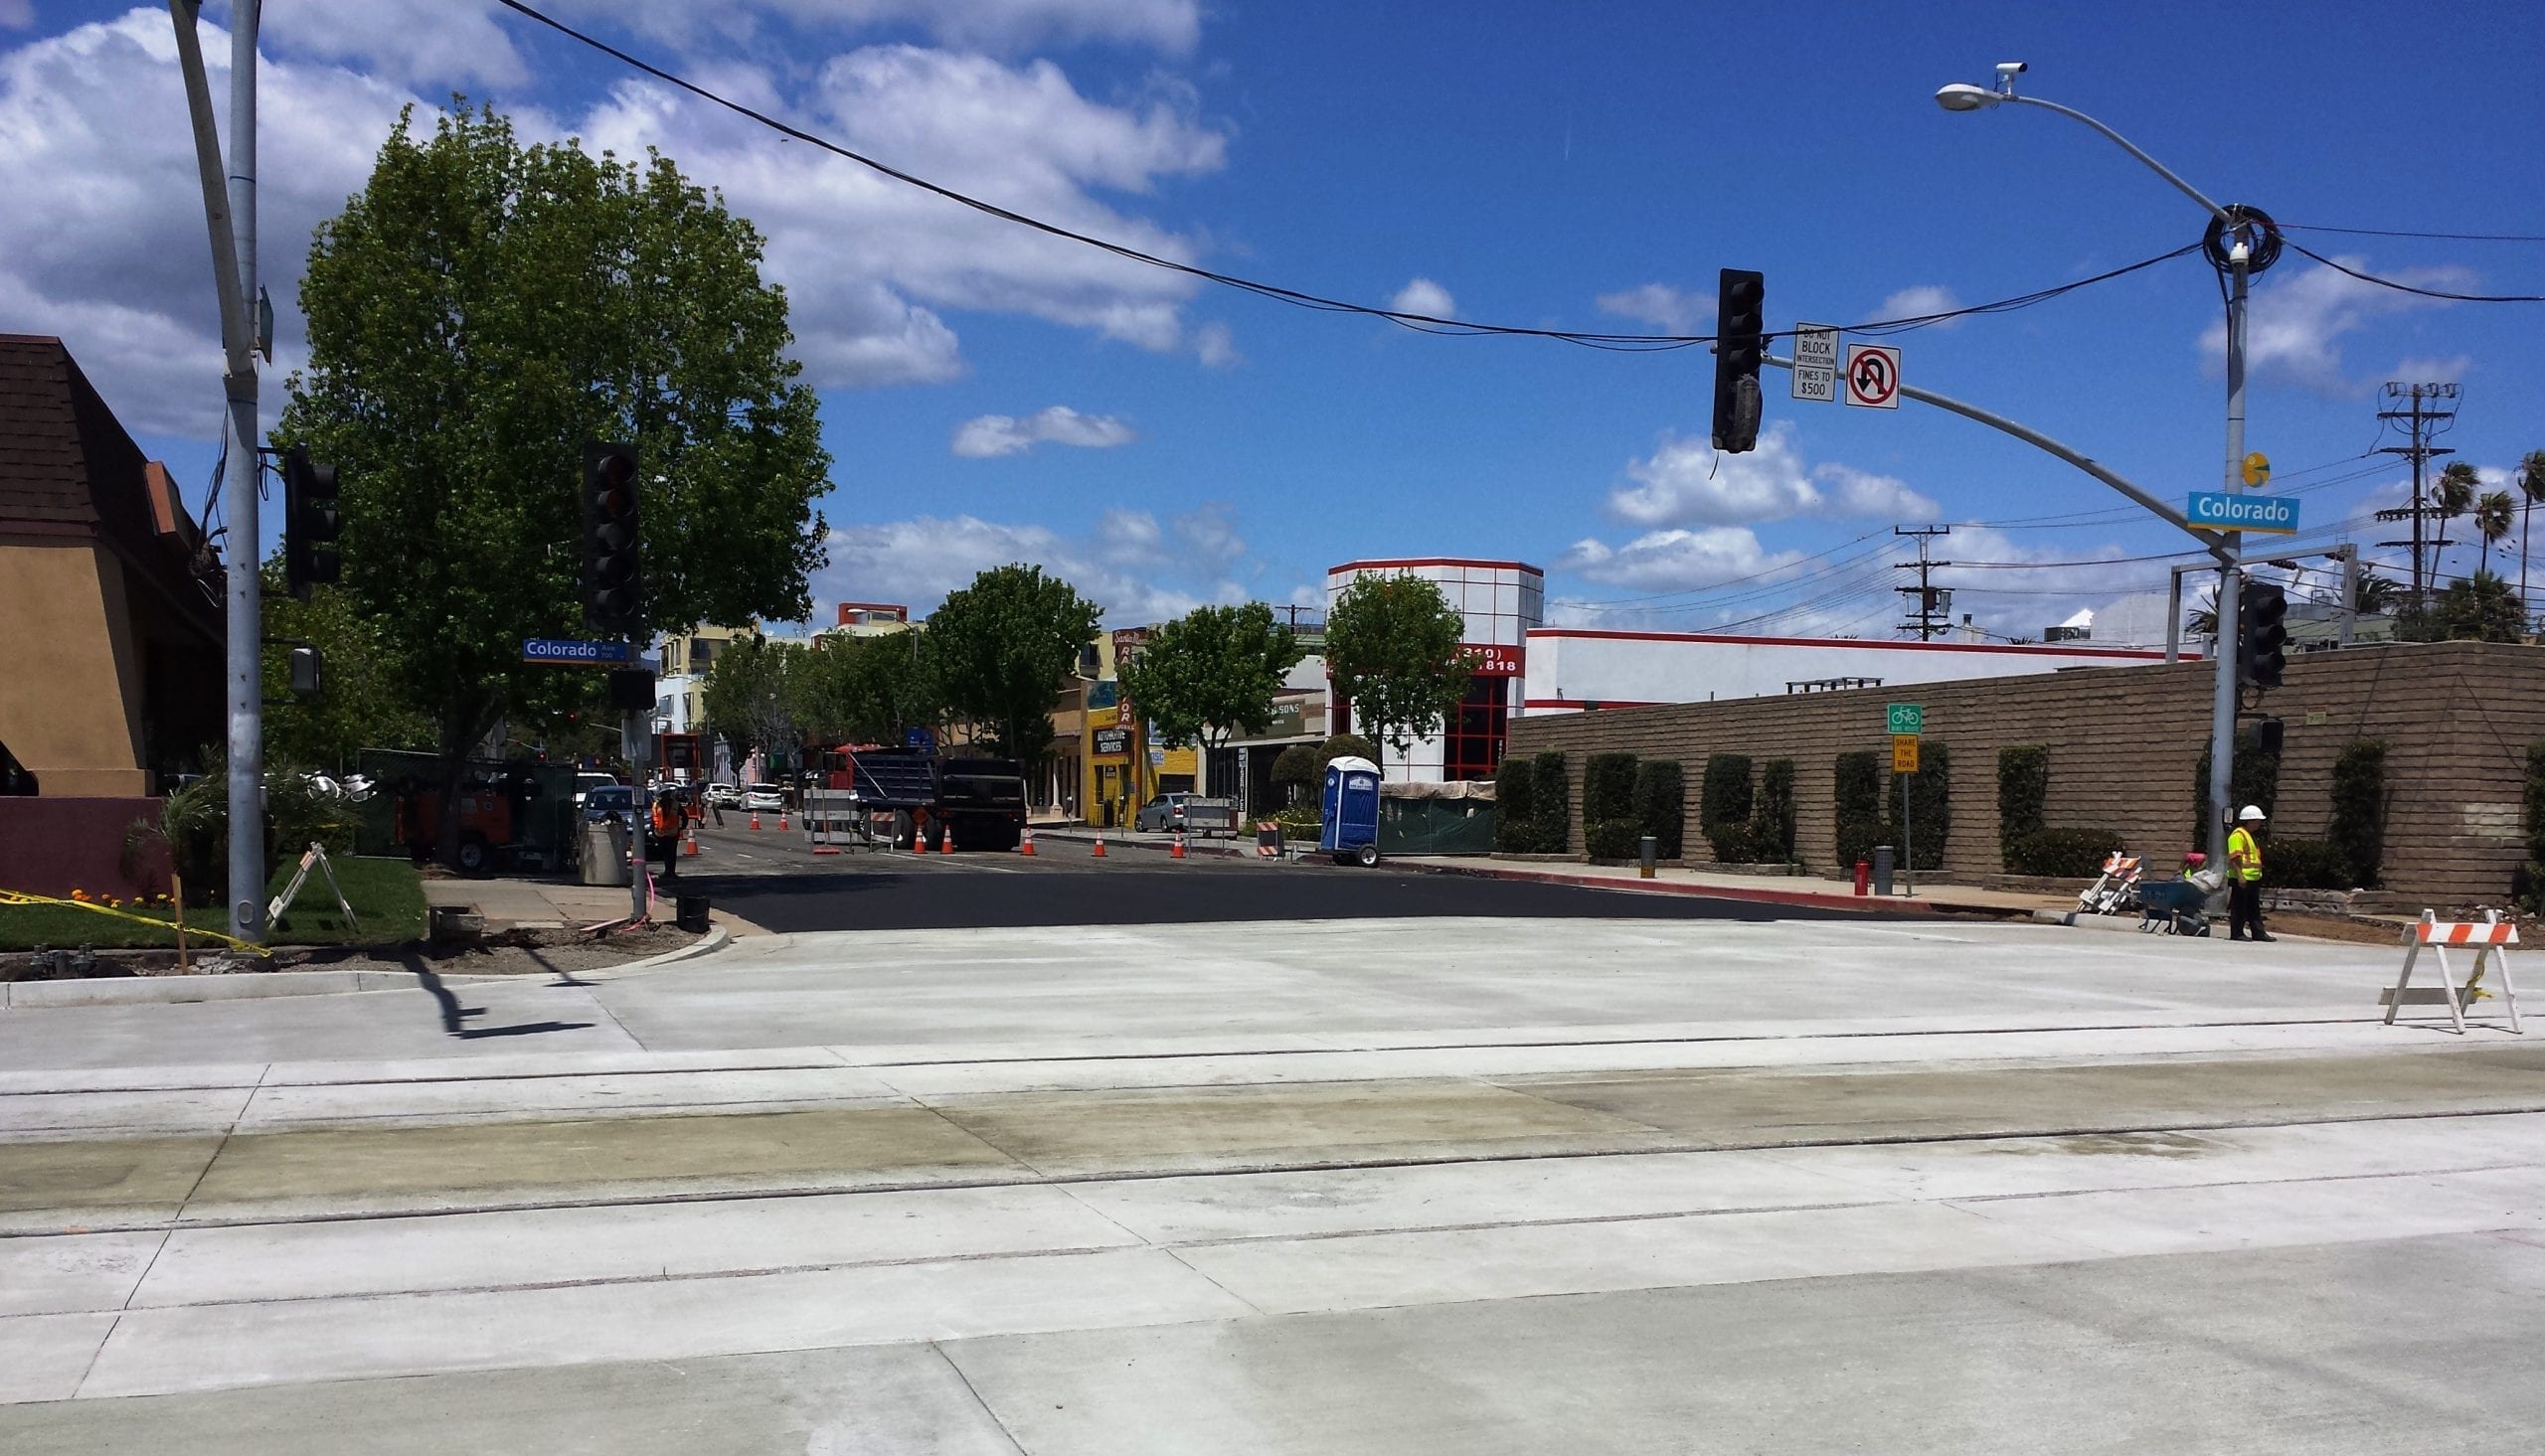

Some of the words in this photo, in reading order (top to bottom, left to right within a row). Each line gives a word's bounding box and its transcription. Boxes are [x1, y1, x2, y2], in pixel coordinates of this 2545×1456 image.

[1801, 341, 1831, 355] BLOCK
[1797, 355, 1834, 365] INTERSECTION
[1798, 370, 1818, 381] FINES
[1822, 372, 1831, 382] TO
[1801, 383, 1825, 396] $500
[2198, 497, 2290, 521] Colorado
[1114, 631, 1133, 643] Santa
[527, 642, 596, 657] Colorado
[1278, 703, 1300, 715] SONS
[1101, 740, 1122, 752] SERVICES
